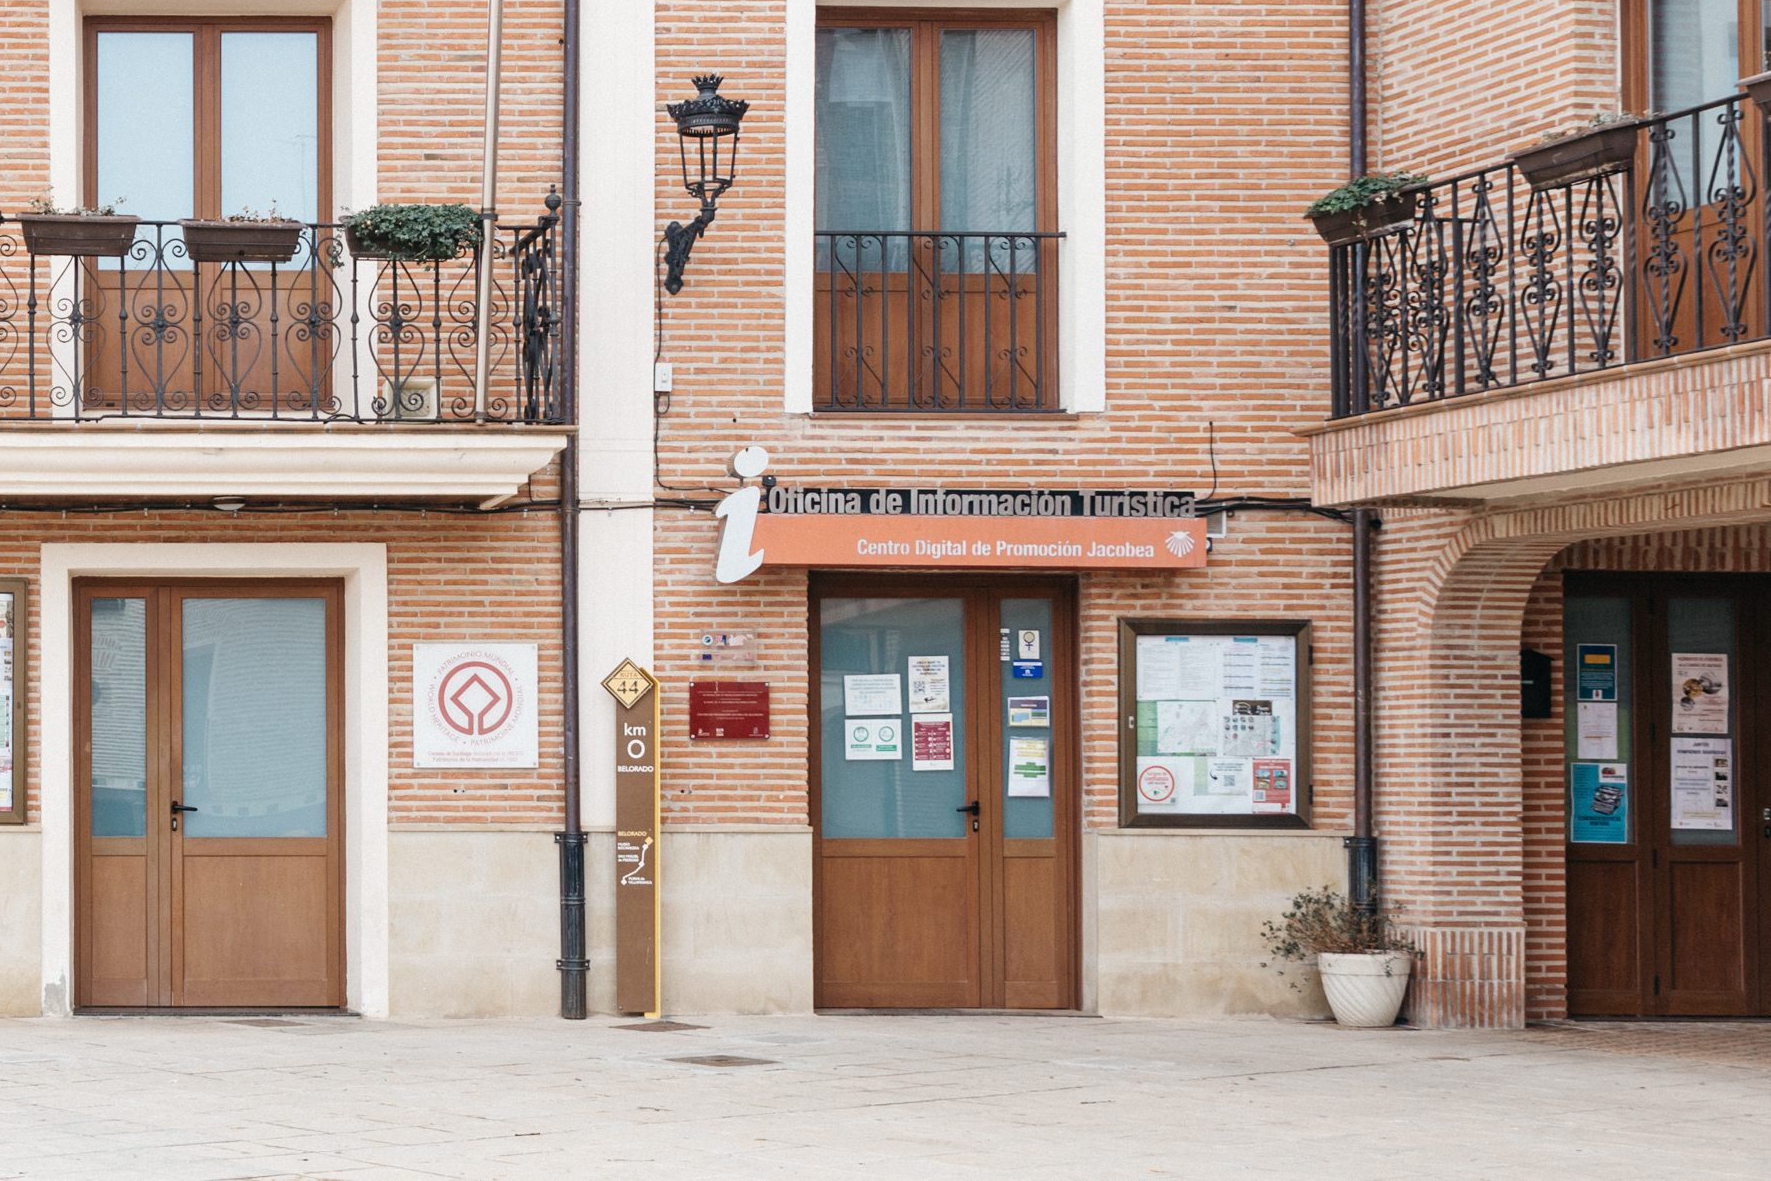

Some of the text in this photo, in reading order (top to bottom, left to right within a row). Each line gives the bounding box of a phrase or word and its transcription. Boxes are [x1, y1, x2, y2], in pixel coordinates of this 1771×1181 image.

[769, 485, 1195, 517] Oficina de Información Turística
[856, 539, 1155, 559] Centro Digital de Promoción Jacobea
[437, 651, 515, 675] PATRIMONIO MUNDIAL
[617, 680, 639, 694] 44
[471, 723, 515, 746] PATRIMOINE
[513, 685, 524, 724] MONDIAL
[431, 714, 460, 743] HERITAGE
[624, 722, 647, 736] km
